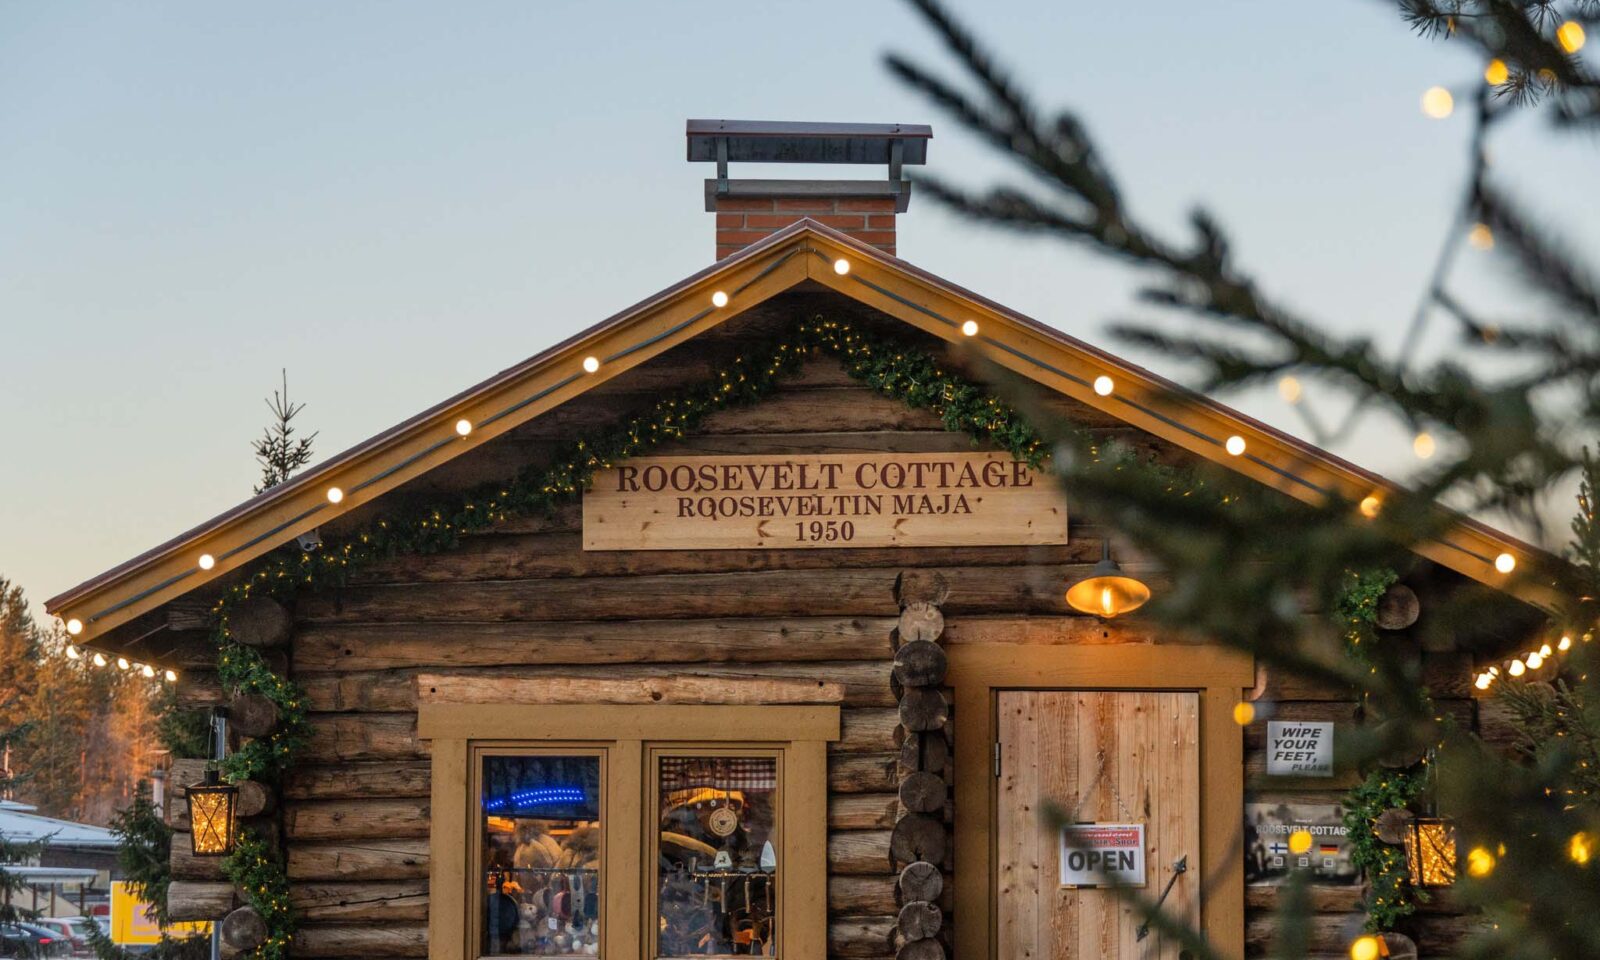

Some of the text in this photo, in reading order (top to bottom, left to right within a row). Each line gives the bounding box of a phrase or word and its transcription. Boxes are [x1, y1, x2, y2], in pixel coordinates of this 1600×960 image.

[616, 460, 1034, 493] ROOSEVELT COTTAGE
[676, 493, 973, 518] ROOSEVELTIN MAJA
[795, 520, 855, 542] 1950
[1282, 727, 1322, 738] WIPE
[1274, 739, 1318, 750] YOUR
[1274, 751, 1317, 763] FEET,
[1068, 850, 1135, 872] OPEN
